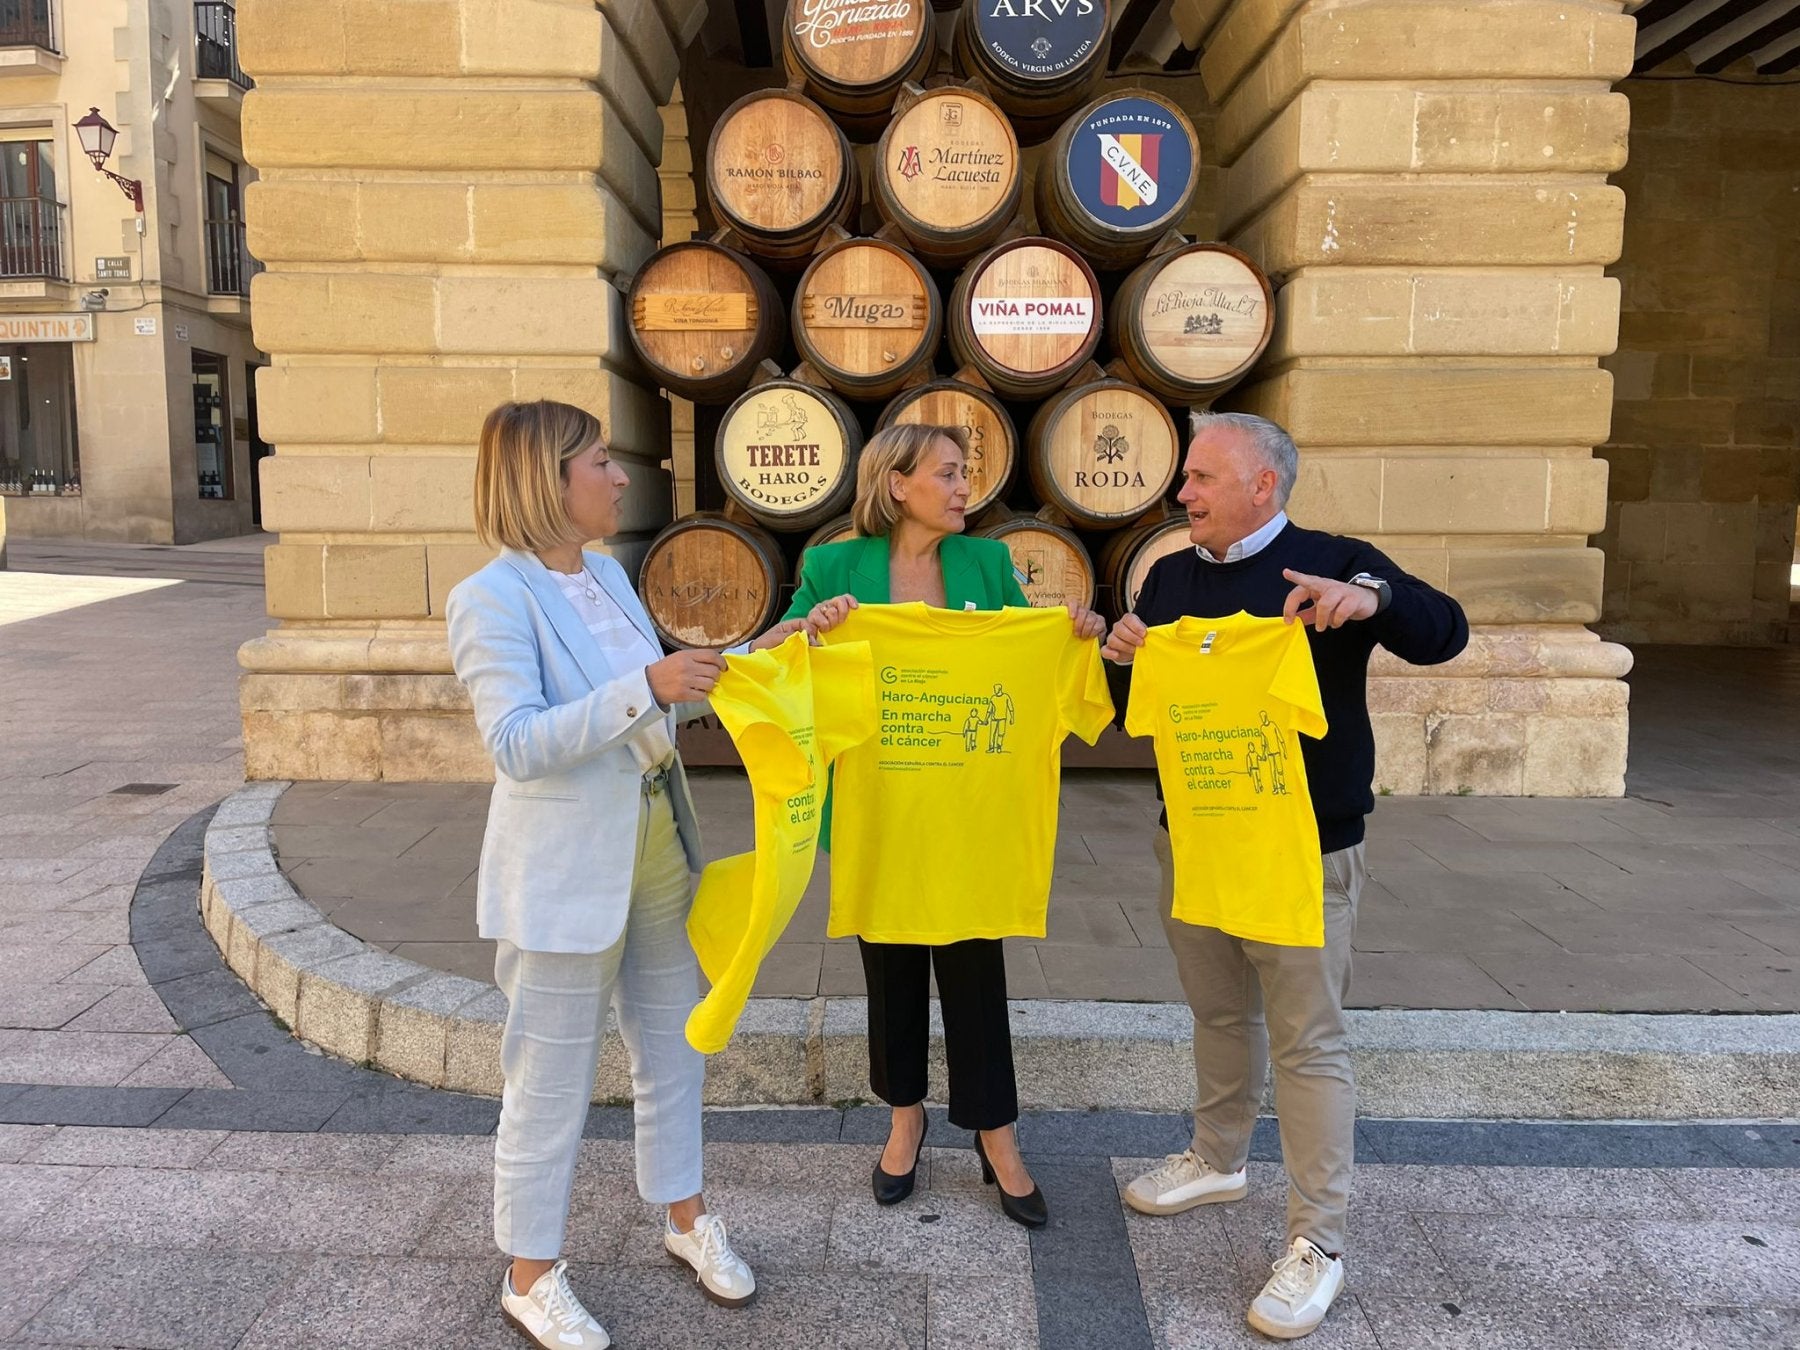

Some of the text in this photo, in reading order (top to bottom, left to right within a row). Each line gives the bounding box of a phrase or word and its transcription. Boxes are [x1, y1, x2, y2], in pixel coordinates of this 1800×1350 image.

[856, 30, 886, 41] FUNDADA
[991, 41, 1019, 67] BODEGA
[1022, 63, 1053, 73] VIRGEN
[1073, 39, 1092, 59] VEGA
[1090, 115, 1172, 130] FUNDADA EN 1879
[928, 147, 1004, 166] Martínez
[726, 167, 822, 179] RAMÓN BILBAO
[932, 165, 1000, 183] Lacuesta
[1107, 146, 1151, 196] C.V.N.E.
[824, 296, 905, 325] Muga
[979, 300, 1086, 316] VIÑA POMAL
[747, 445, 819, 466] TERETE
[759, 472, 809, 484] HARO
[1075, 472, 1145, 487] RODA
[740, 476, 826, 504] BODEGAS
[882, 691, 989, 706] Haro-Anguciana
[882, 709, 951, 722] En marcha
[881, 724, 924, 733] contra
[1175, 725, 1261, 742] Haro-Anguciana
[881, 736, 941, 747] el cáncer
[1180, 748, 1233, 763] En marcha
[1184, 764, 1215, 776] contra
[1187, 777, 1232, 790] el cáncer
[790, 810, 801, 824] el
